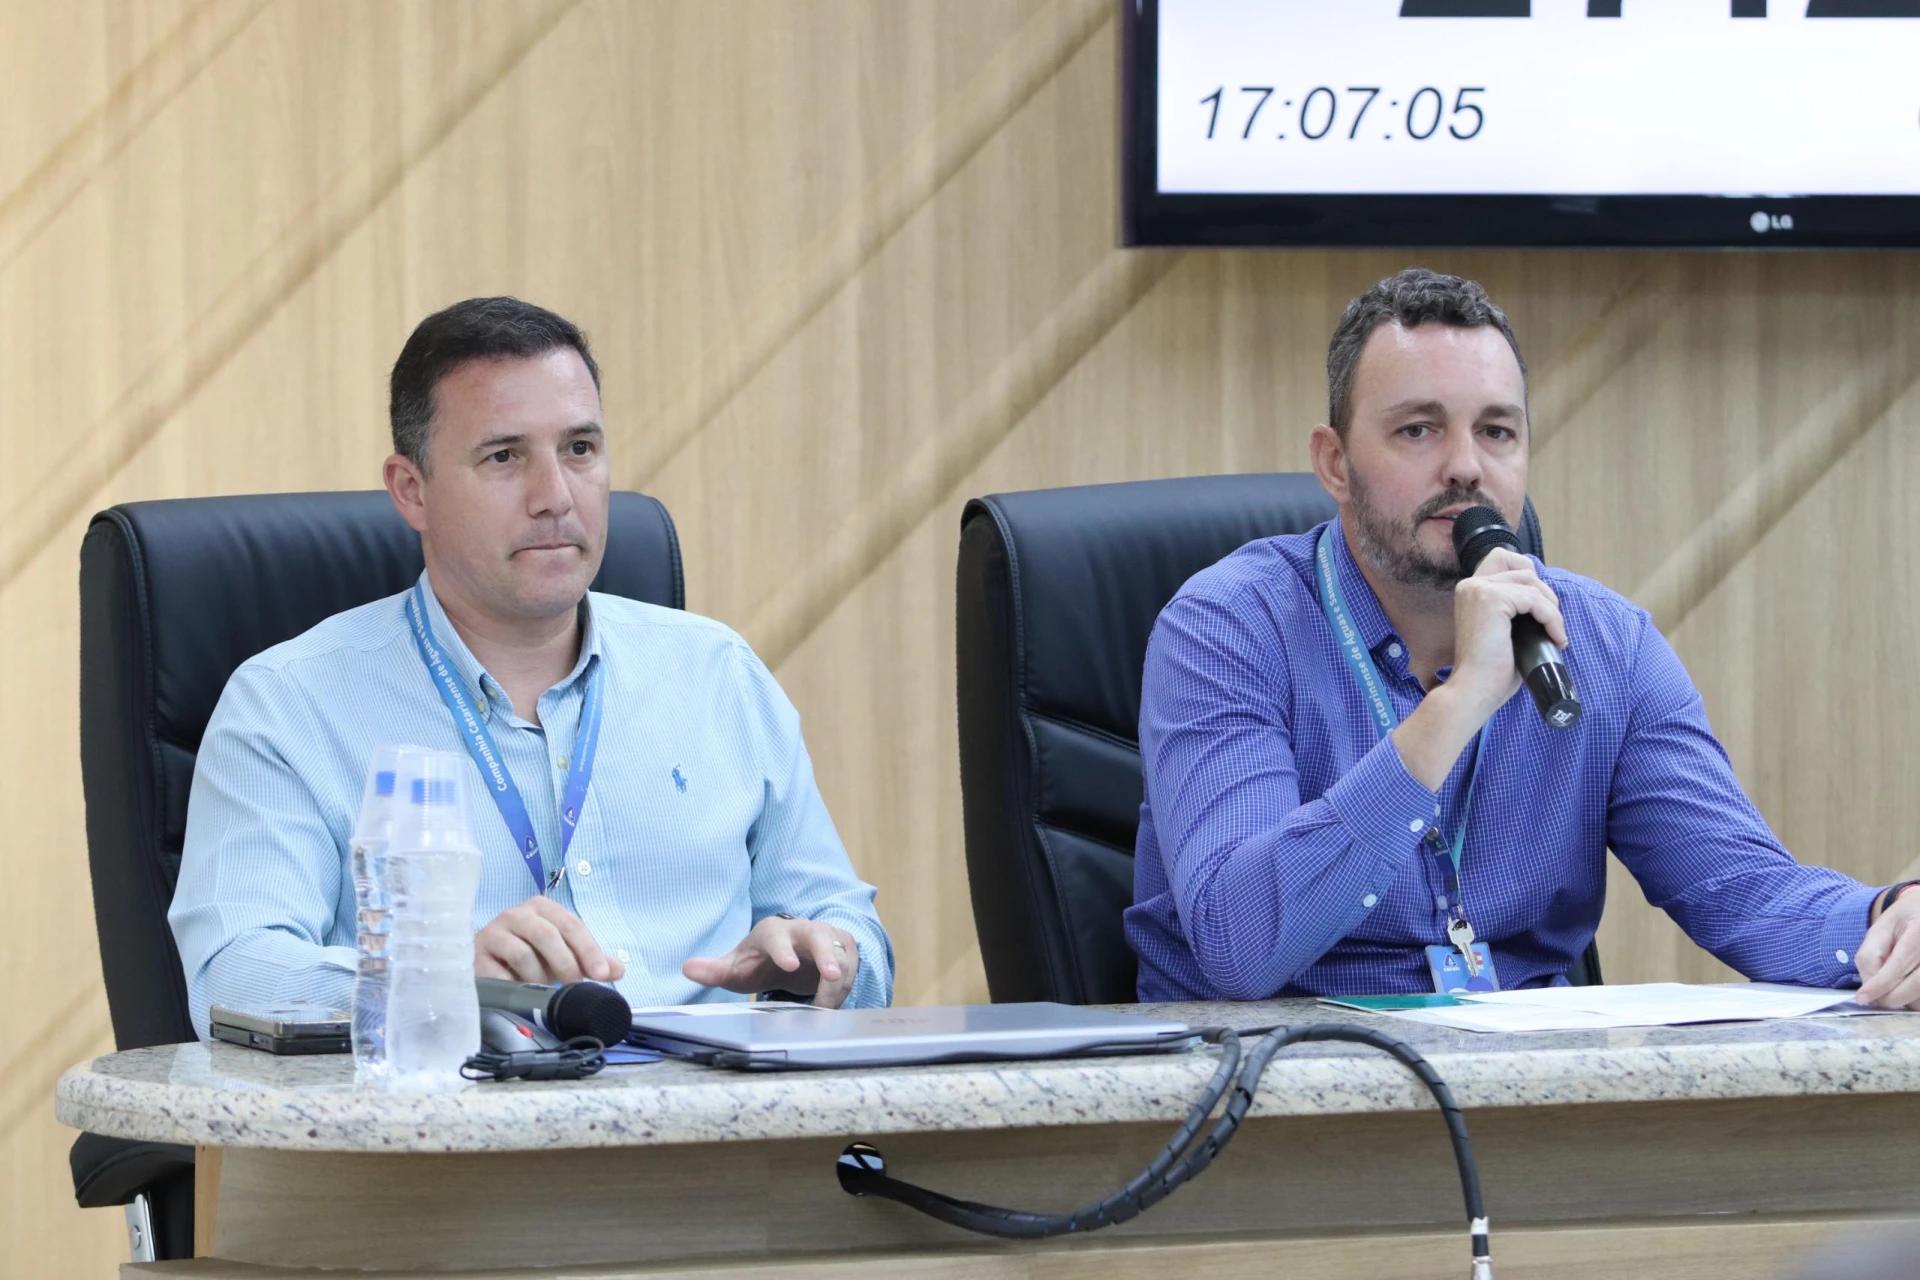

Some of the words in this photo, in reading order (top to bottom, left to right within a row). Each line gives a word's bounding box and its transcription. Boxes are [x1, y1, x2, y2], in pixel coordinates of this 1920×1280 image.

[1201, 86, 1486, 141] 17:07:05
[1318, 546, 1338, 607] Saneamento
[1336, 612, 1356, 647] Águas
[1351, 646, 1363, 662] de
[437, 665, 447, 677] de
[1358, 662, 1391, 728] Catarinense
[444, 675, 480, 734] Catarinense
[474, 734, 508, 792] Companhia
